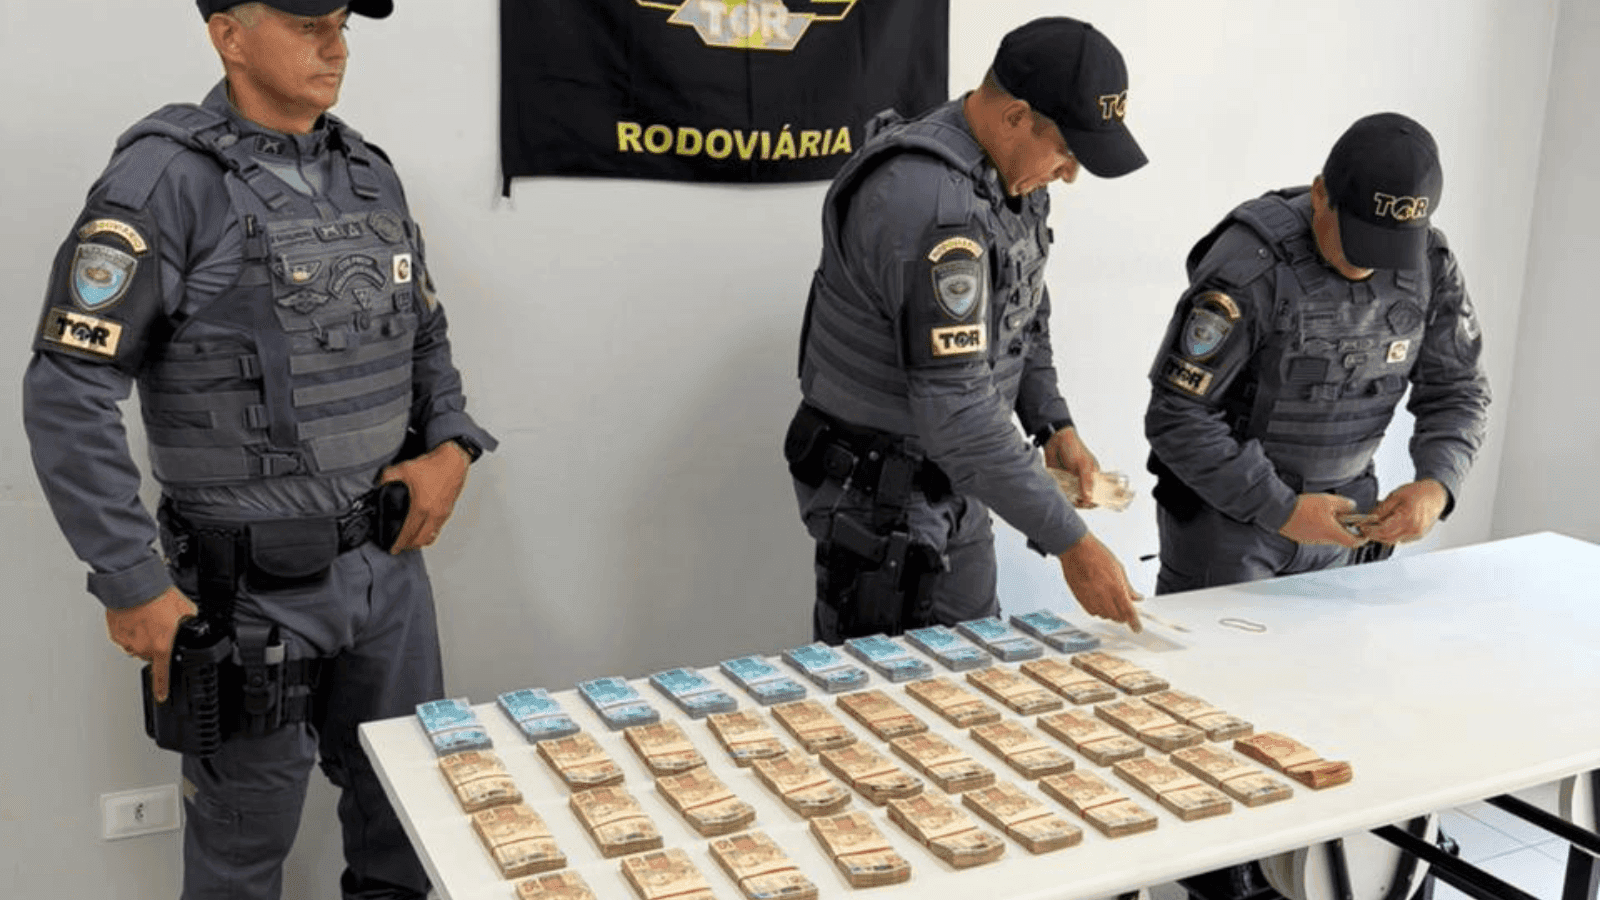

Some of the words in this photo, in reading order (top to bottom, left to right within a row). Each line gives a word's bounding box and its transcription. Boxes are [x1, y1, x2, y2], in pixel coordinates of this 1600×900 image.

[700, 1, 791, 40] TOR
[616, 121, 852, 160] RODOVIÁRIA
[1374, 192, 1429, 220] TOR
[56, 316, 111, 347] TOR
[938, 329, 980, 349] TOR
